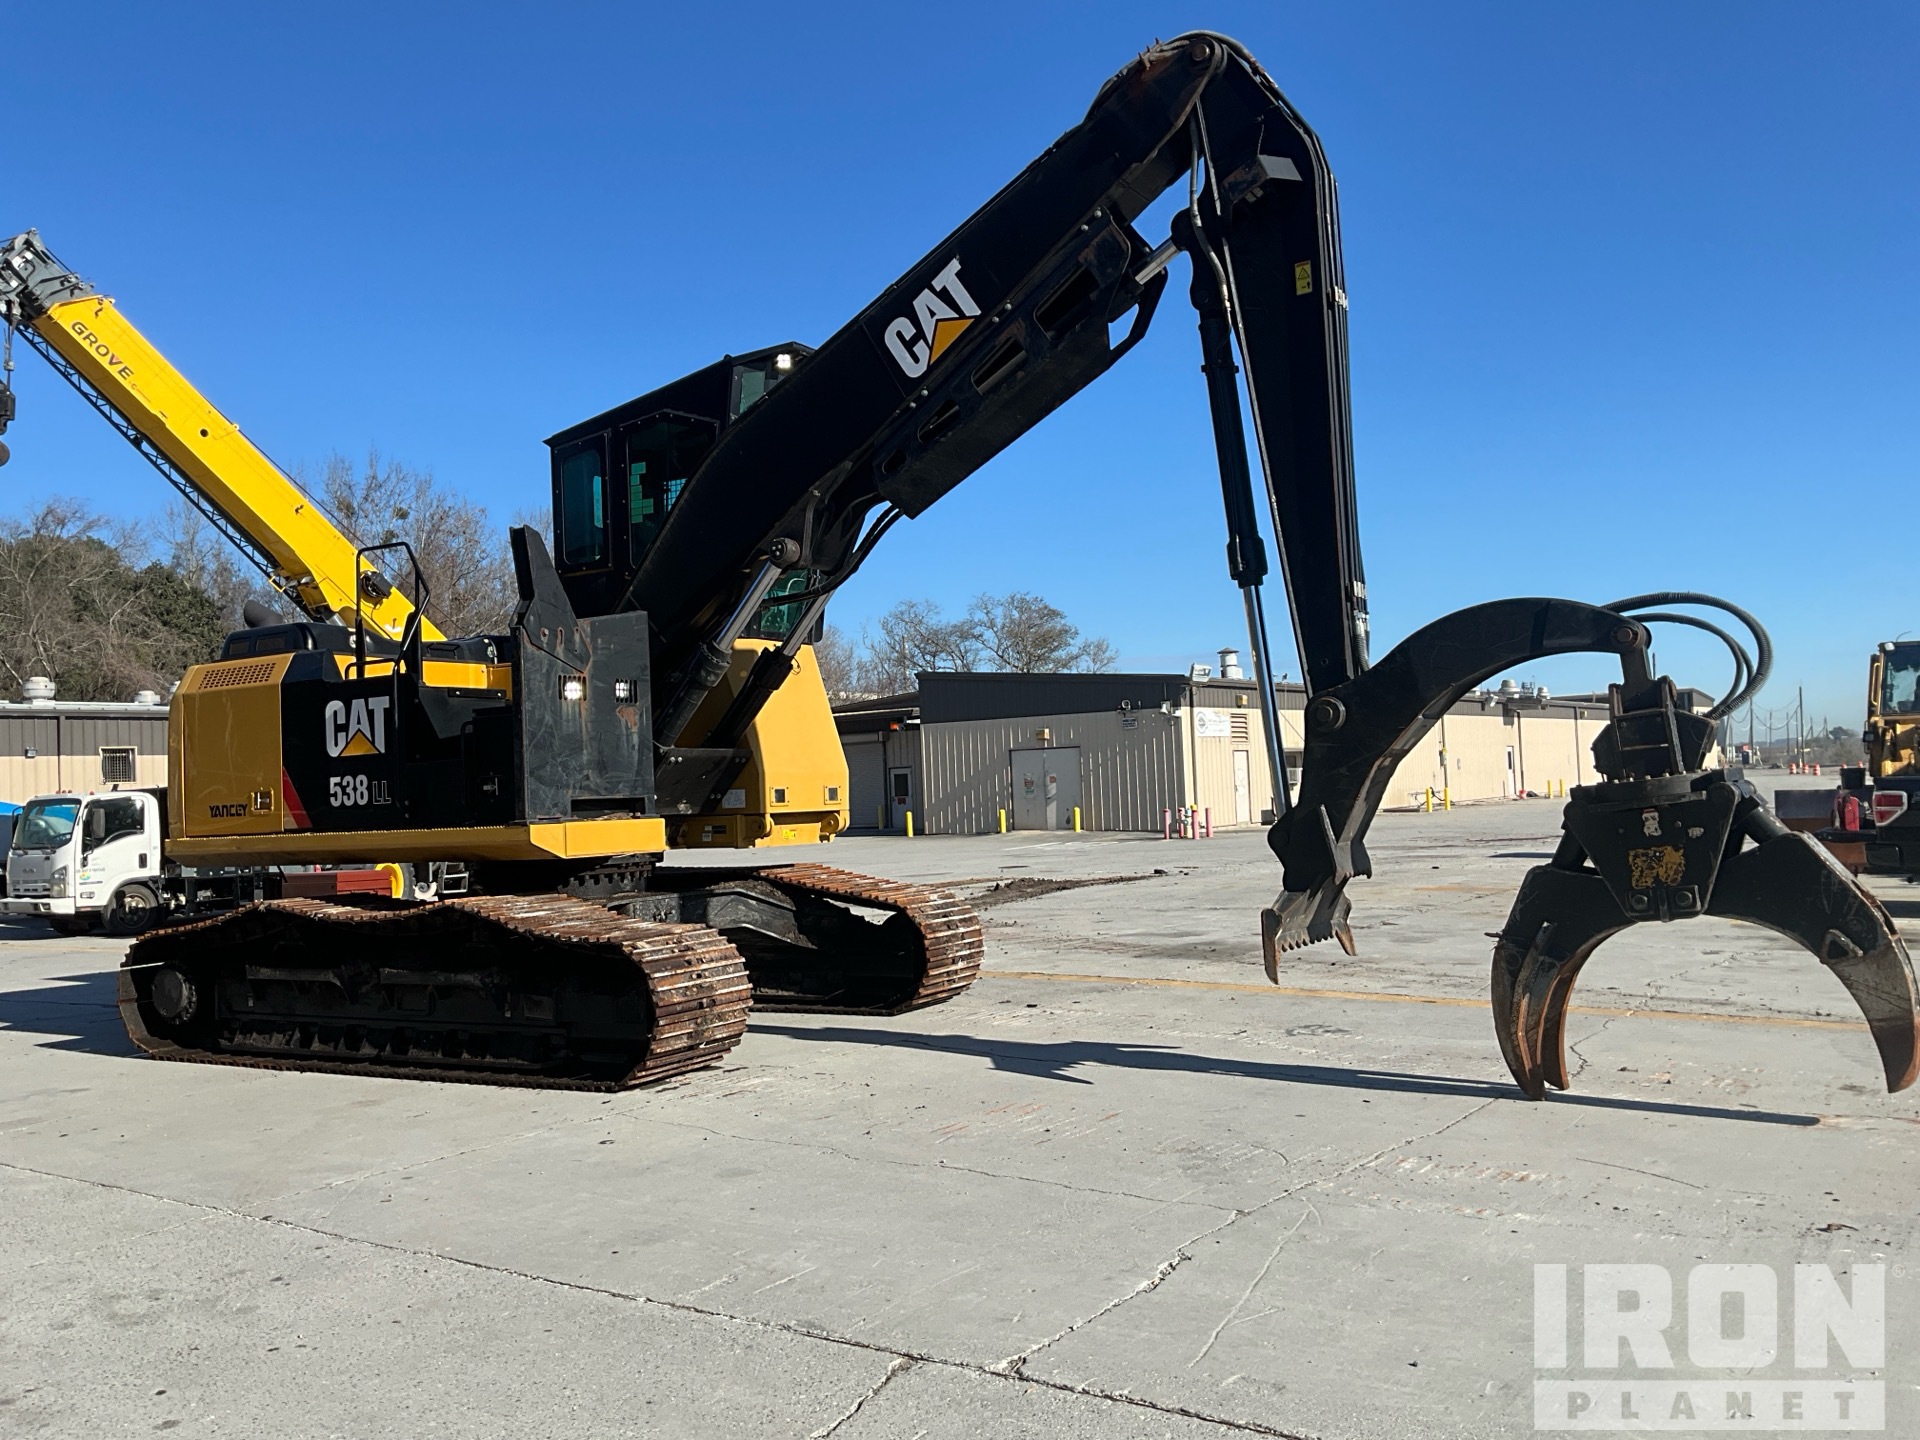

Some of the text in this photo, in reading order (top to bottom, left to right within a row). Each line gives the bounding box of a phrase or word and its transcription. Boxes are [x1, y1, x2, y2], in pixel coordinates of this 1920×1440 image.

[884, 257, 982, 378] CAT
[71, 321, 135, 381] GROVE
[325, 696, 390, 758] CAT
[209, 803, 248, 818] YANCEY
[329, 774, 392, 807] 538 LL
